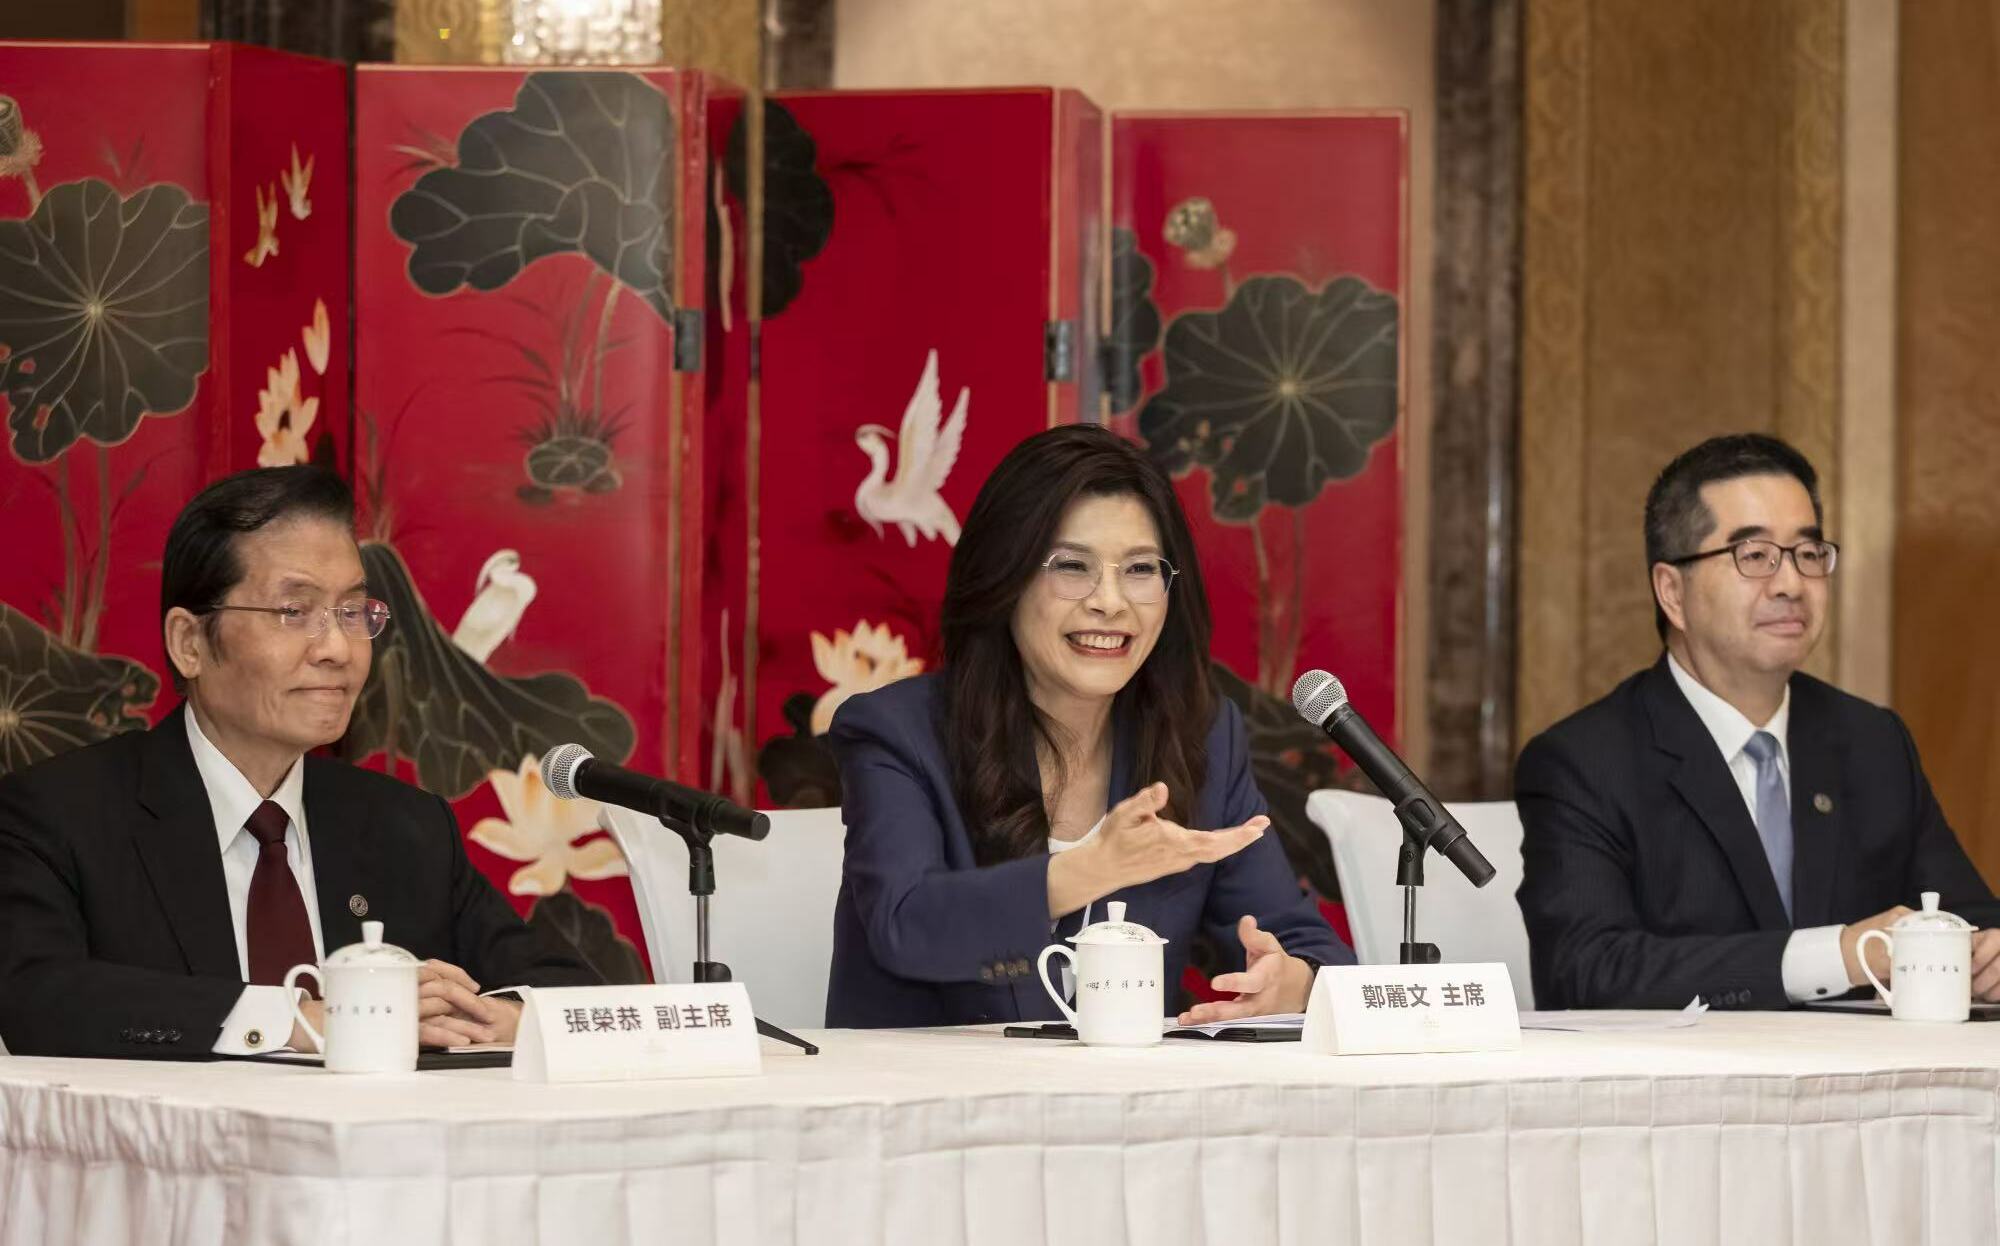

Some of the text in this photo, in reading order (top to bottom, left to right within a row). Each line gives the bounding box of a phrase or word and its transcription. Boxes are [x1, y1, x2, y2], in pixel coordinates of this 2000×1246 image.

[1361, 982, 1486, 1009] 鄭麗文 主席
[563, 1003, 732, 1034] 張榮恭 副主席
